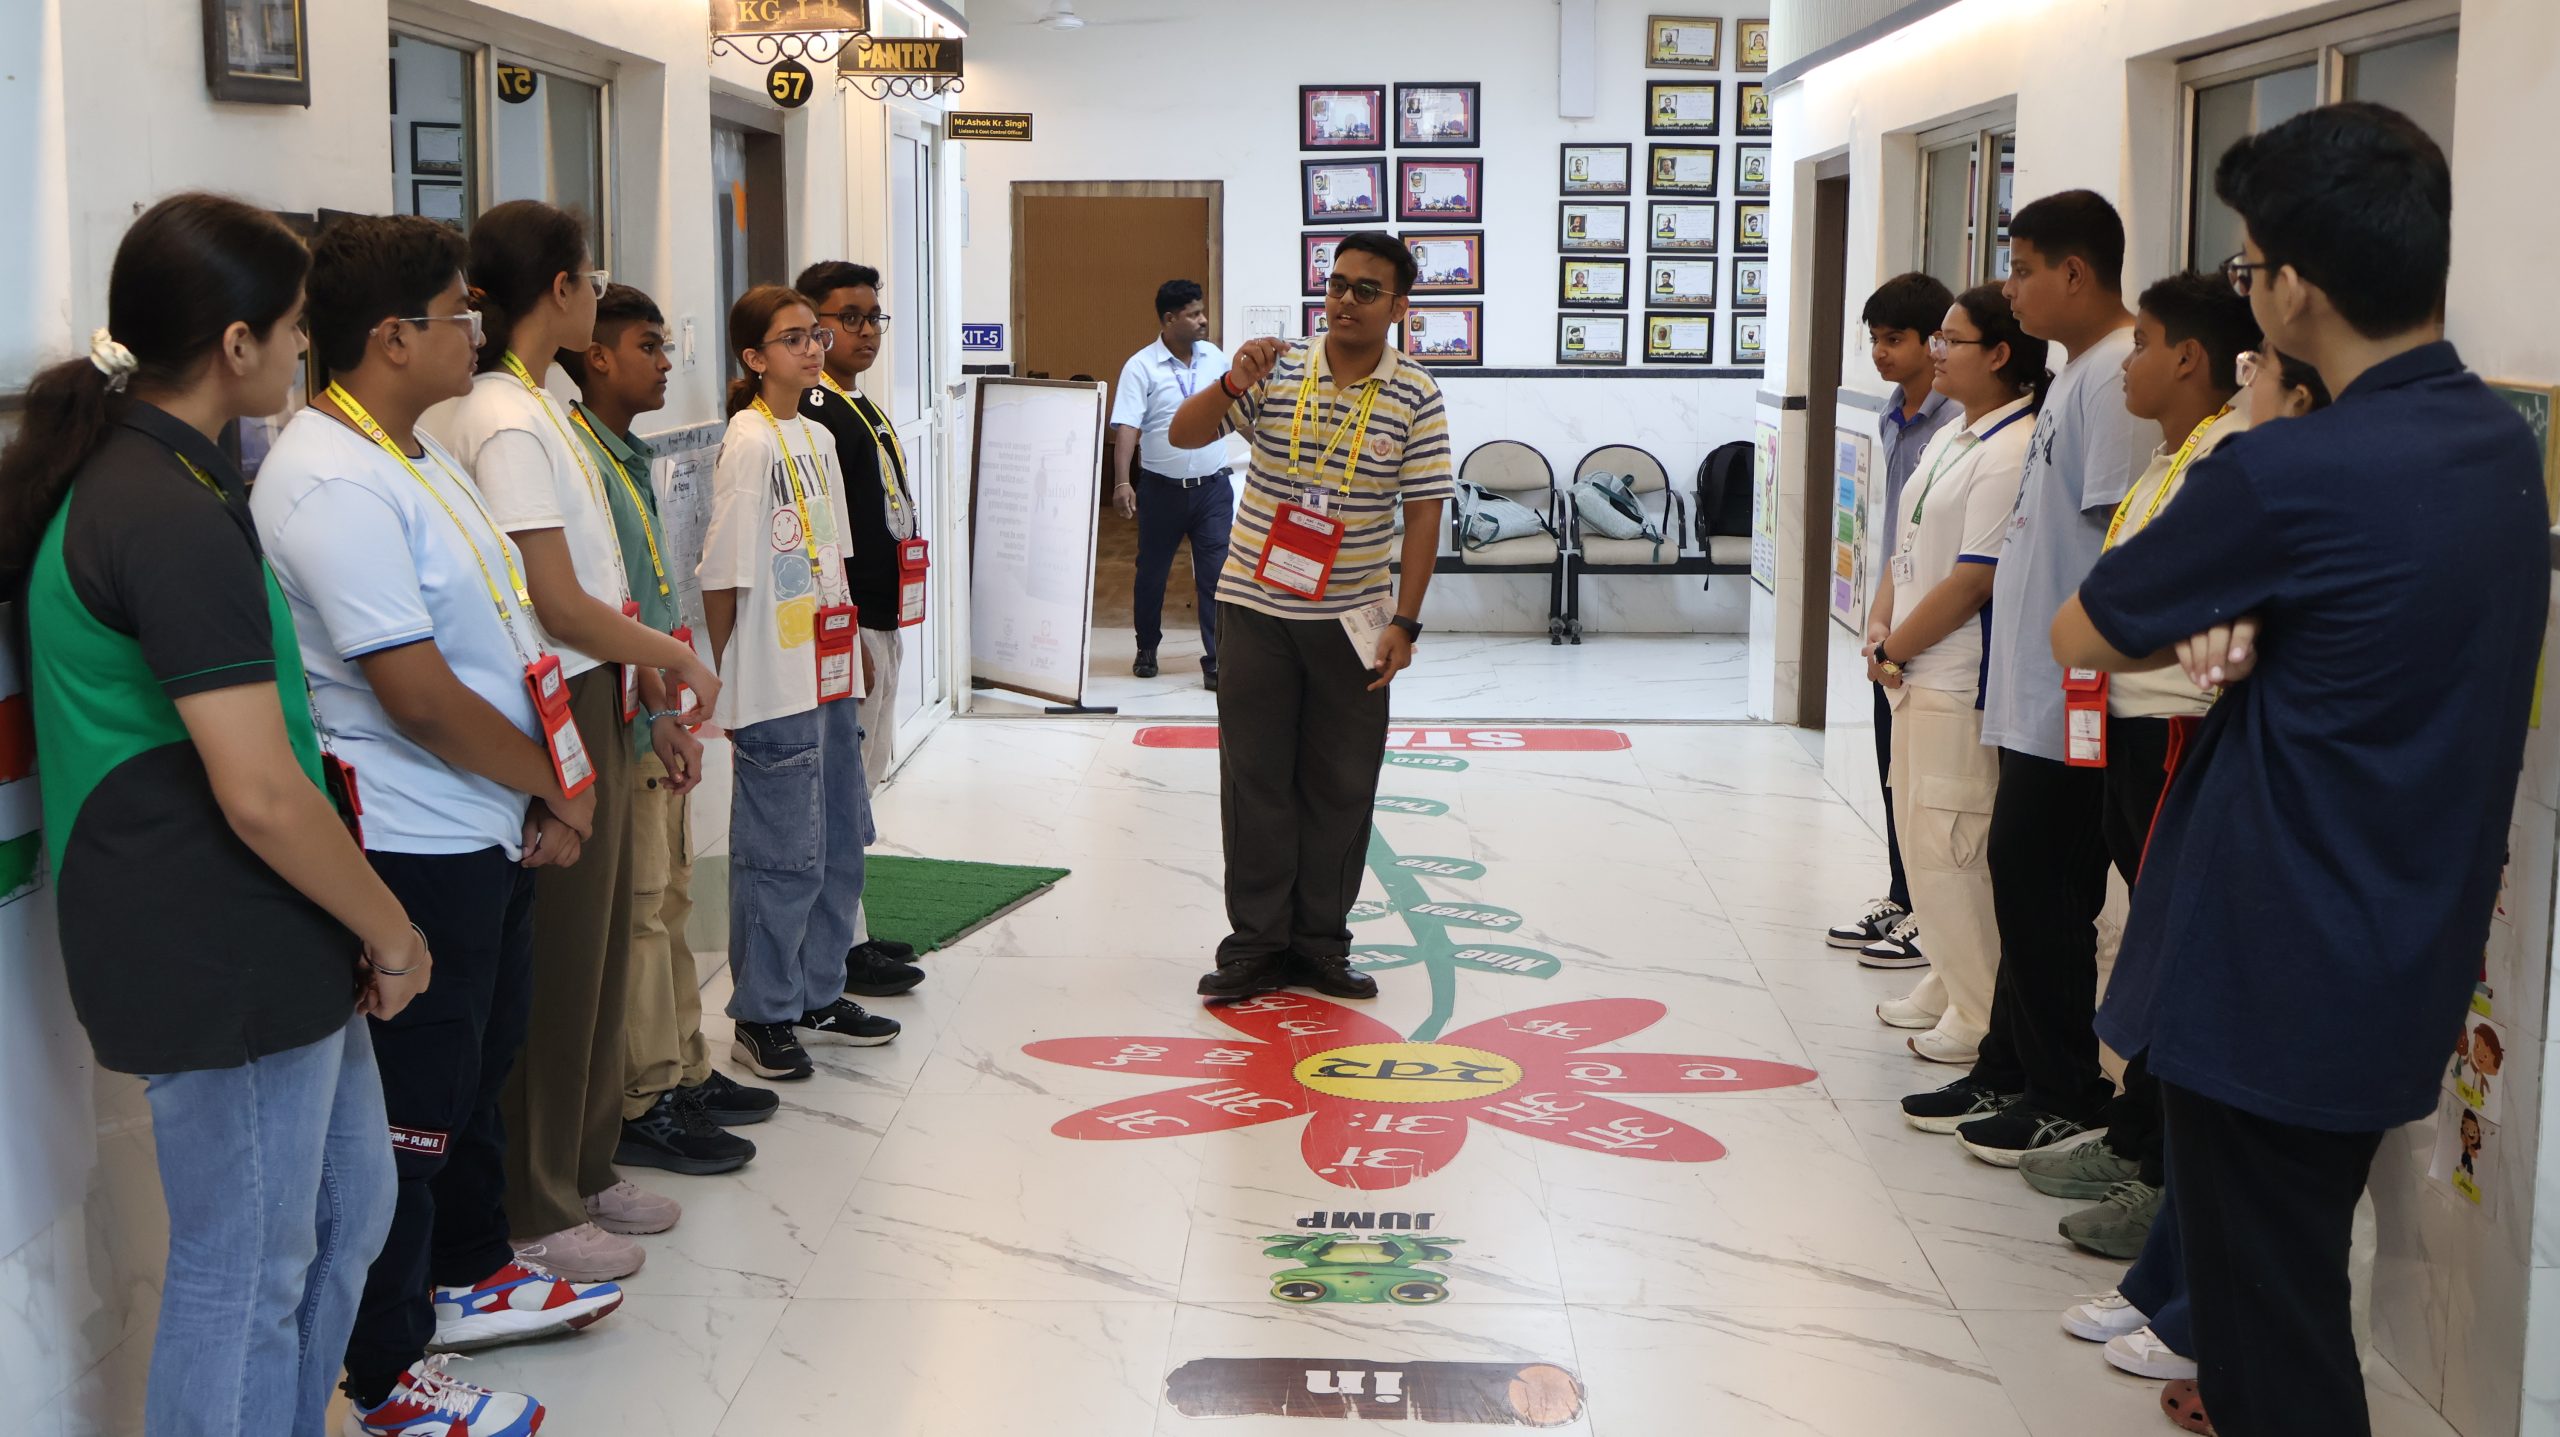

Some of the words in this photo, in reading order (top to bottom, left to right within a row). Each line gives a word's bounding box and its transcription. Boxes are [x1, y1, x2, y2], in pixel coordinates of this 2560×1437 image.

[858, 43, 941, 70] PANTRY
[772, 71, 807, 100] 57
[992, 119, 1004, 127] Kr.
[1005, 120, 1028, 129] Singh
[961, 330, 999, 345] XIT-5
[809, 388, 825, 407] 8
[1392, 757, 1461, 767] Zero
[1374, 799, 1437, 813] Two
[1395, 858, 1472, 875] Five
[1409, 903, 1522, 927] Seven
[1345, 950, 1408, 966] Te
[1454, 949, 1550, 972] Nine
[1311, 1057, 1504, 1083] स्वर
[1296, 1211, 1436, 1230] JUMP
[1305, 1369, 1404, 1404] in
